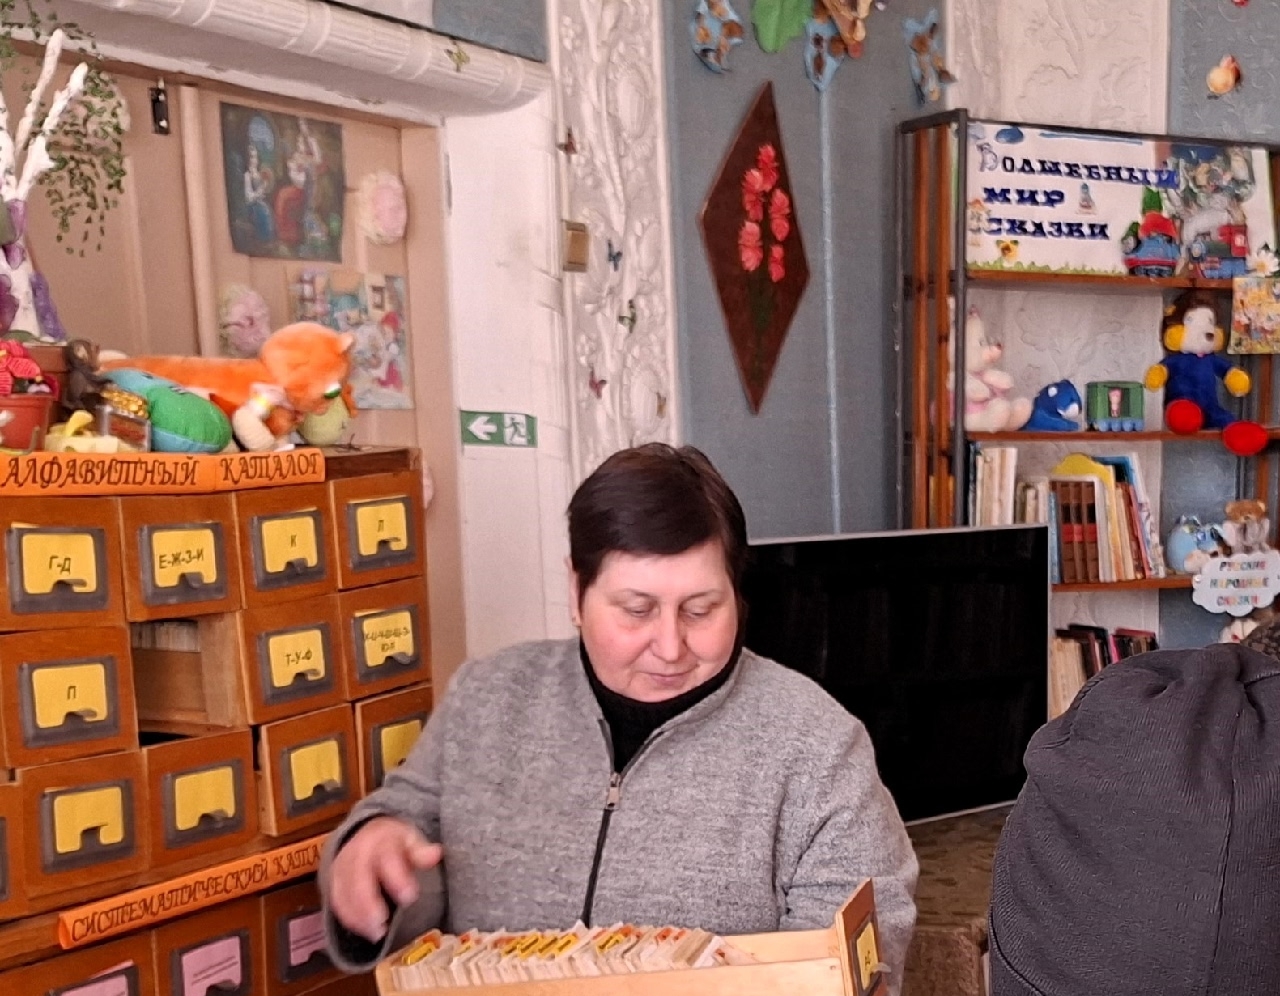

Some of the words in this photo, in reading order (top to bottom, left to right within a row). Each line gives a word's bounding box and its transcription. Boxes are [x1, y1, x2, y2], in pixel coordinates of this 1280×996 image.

[975, 141, 1180, 190] ВОЛШЕБНЫЙ
[982, 186, 1065, 208] МИР
[984, 216, 1110, 240] СКАЗКИ
[1, 455, 200, 489] АЛФАВИТНЫЙ
[220, 453, 320, 485] КАТАЛОГ
[290, 534, 297, 548] К
[48, 555, 72, 575] Г-Д
[158, 548, 205, 569] Е-Ж-З-И
[66, 685, 77, 700] П
[72, 858, 269, 942] СИСТЕМАТИЧЕСКИЙ
[272, 840, 324, 876] КАТА
